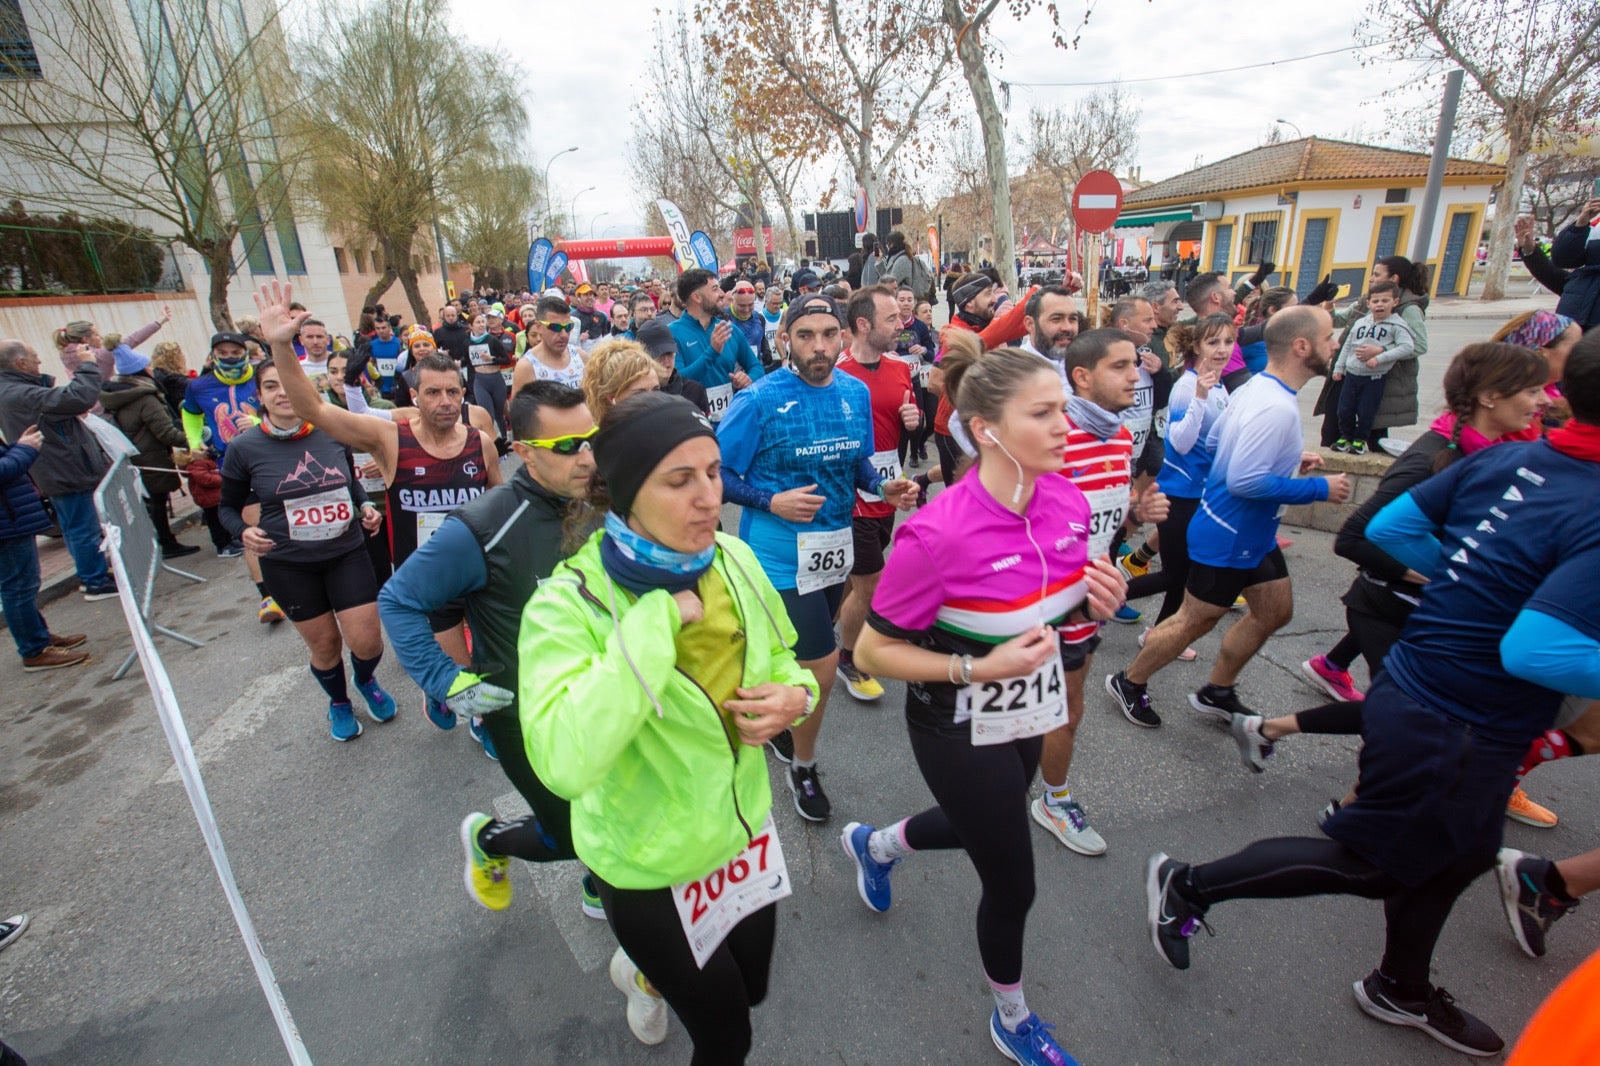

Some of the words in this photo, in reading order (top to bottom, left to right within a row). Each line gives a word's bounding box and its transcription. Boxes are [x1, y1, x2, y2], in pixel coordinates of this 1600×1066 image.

[1356, 325, 1388, 341] GAP
[708, 395, 729, 412] 191
[796, 445, 828, 457] PAZITO
[835, 440, 861, 452] PAZITO
[399, 486, 486, 507] GRANAD
[292, 502, 351, 527] 2058
[1089, 508, 1123, 536] 379
[808, 548, 845, 572] 363
[981, 664, 1061, 713] 2214
[683, 833, 770, 925] 2067
